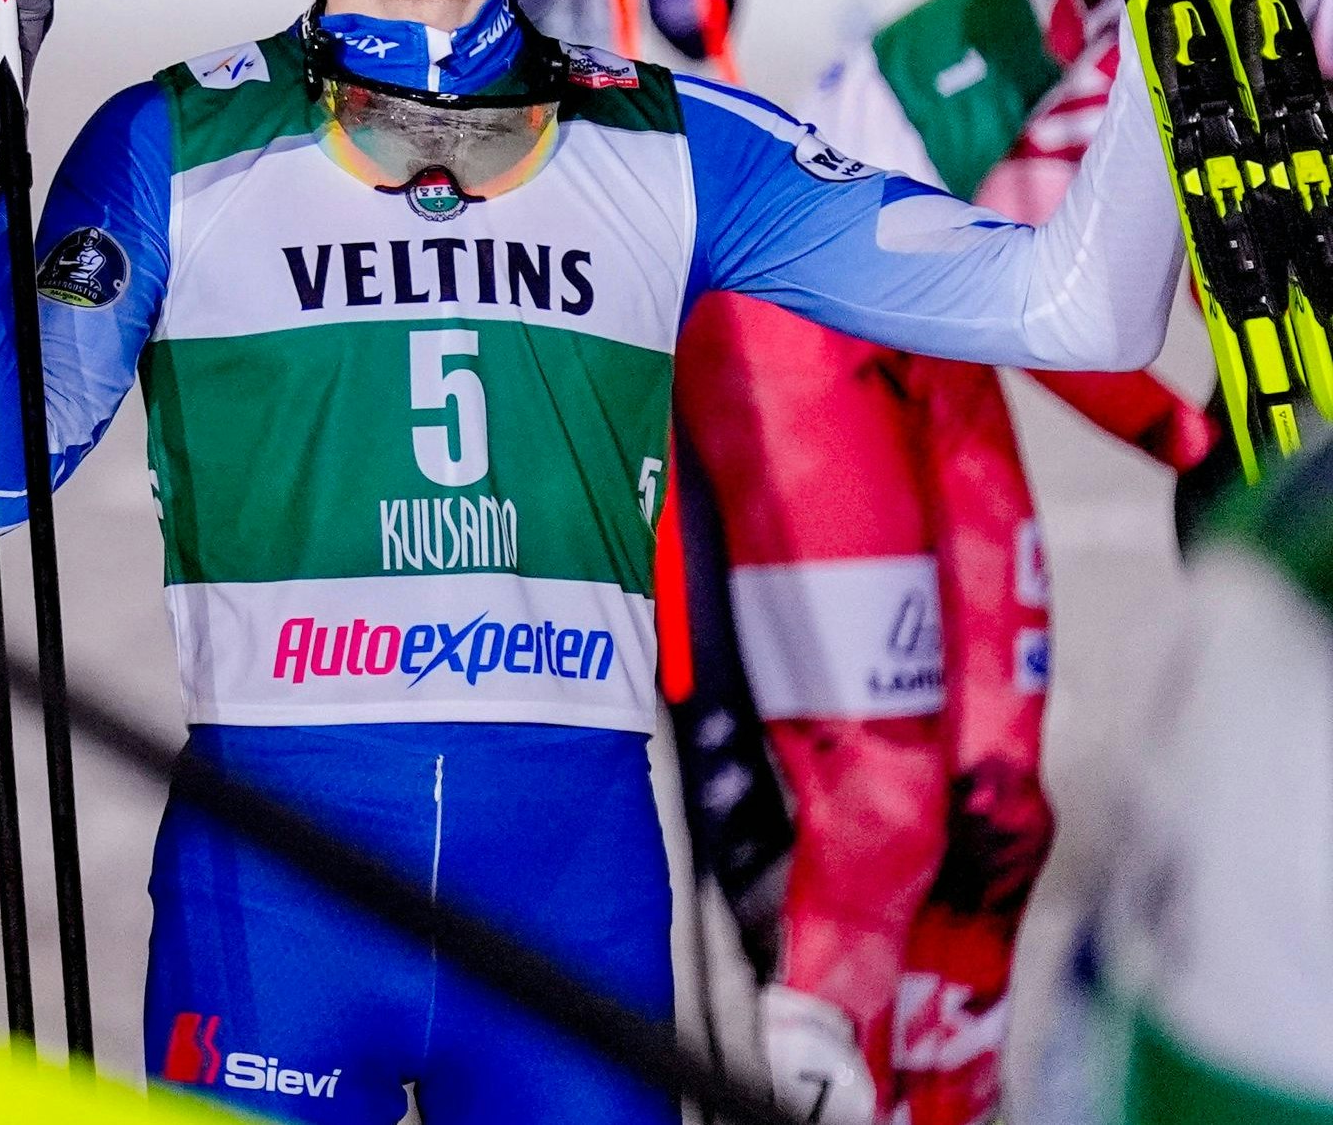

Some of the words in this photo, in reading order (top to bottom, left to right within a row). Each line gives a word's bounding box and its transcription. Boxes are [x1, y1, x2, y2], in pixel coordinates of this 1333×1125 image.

[281, 237, 594, 316] VELTINS
[409, 329, 490, 487] 5
[379, 497, 519, 573] KUUSAMO
[272, 611, 615, 687] Autoexperten
[224, 1051, 342, 1098] Sievi
